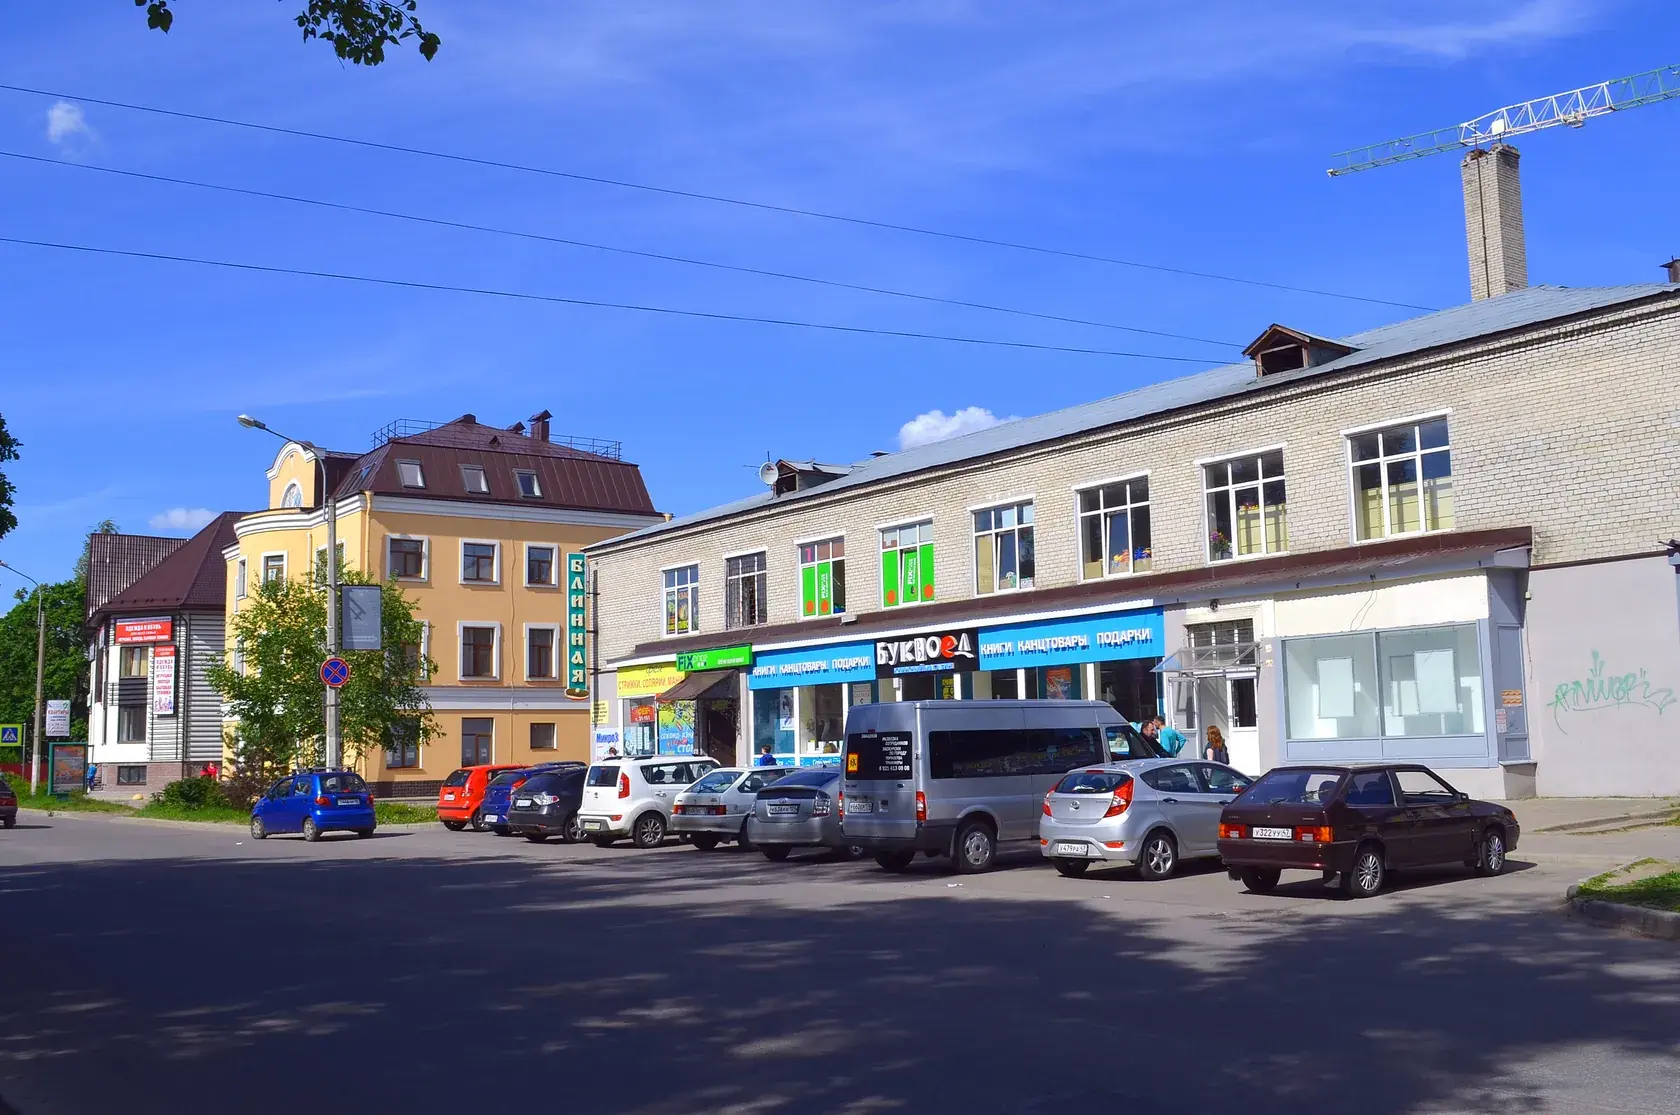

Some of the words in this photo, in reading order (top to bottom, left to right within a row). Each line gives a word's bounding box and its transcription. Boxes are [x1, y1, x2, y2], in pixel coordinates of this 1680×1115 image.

[570, 559, 584, 684] БЛИННАЯ
[980, 641, 1014, 655] КНИГИ
[1017, 633, 1088, 652] КАНЦТОВАРЫ
[1096, 628, 1153, 645] ПОДАРКИ
[752, 664, 777, 676] КНИГИ
[779, 660, 828, 674] КАНЦТОВАРЫ
[831, 656, 872, 670] ПОДАРКИ
